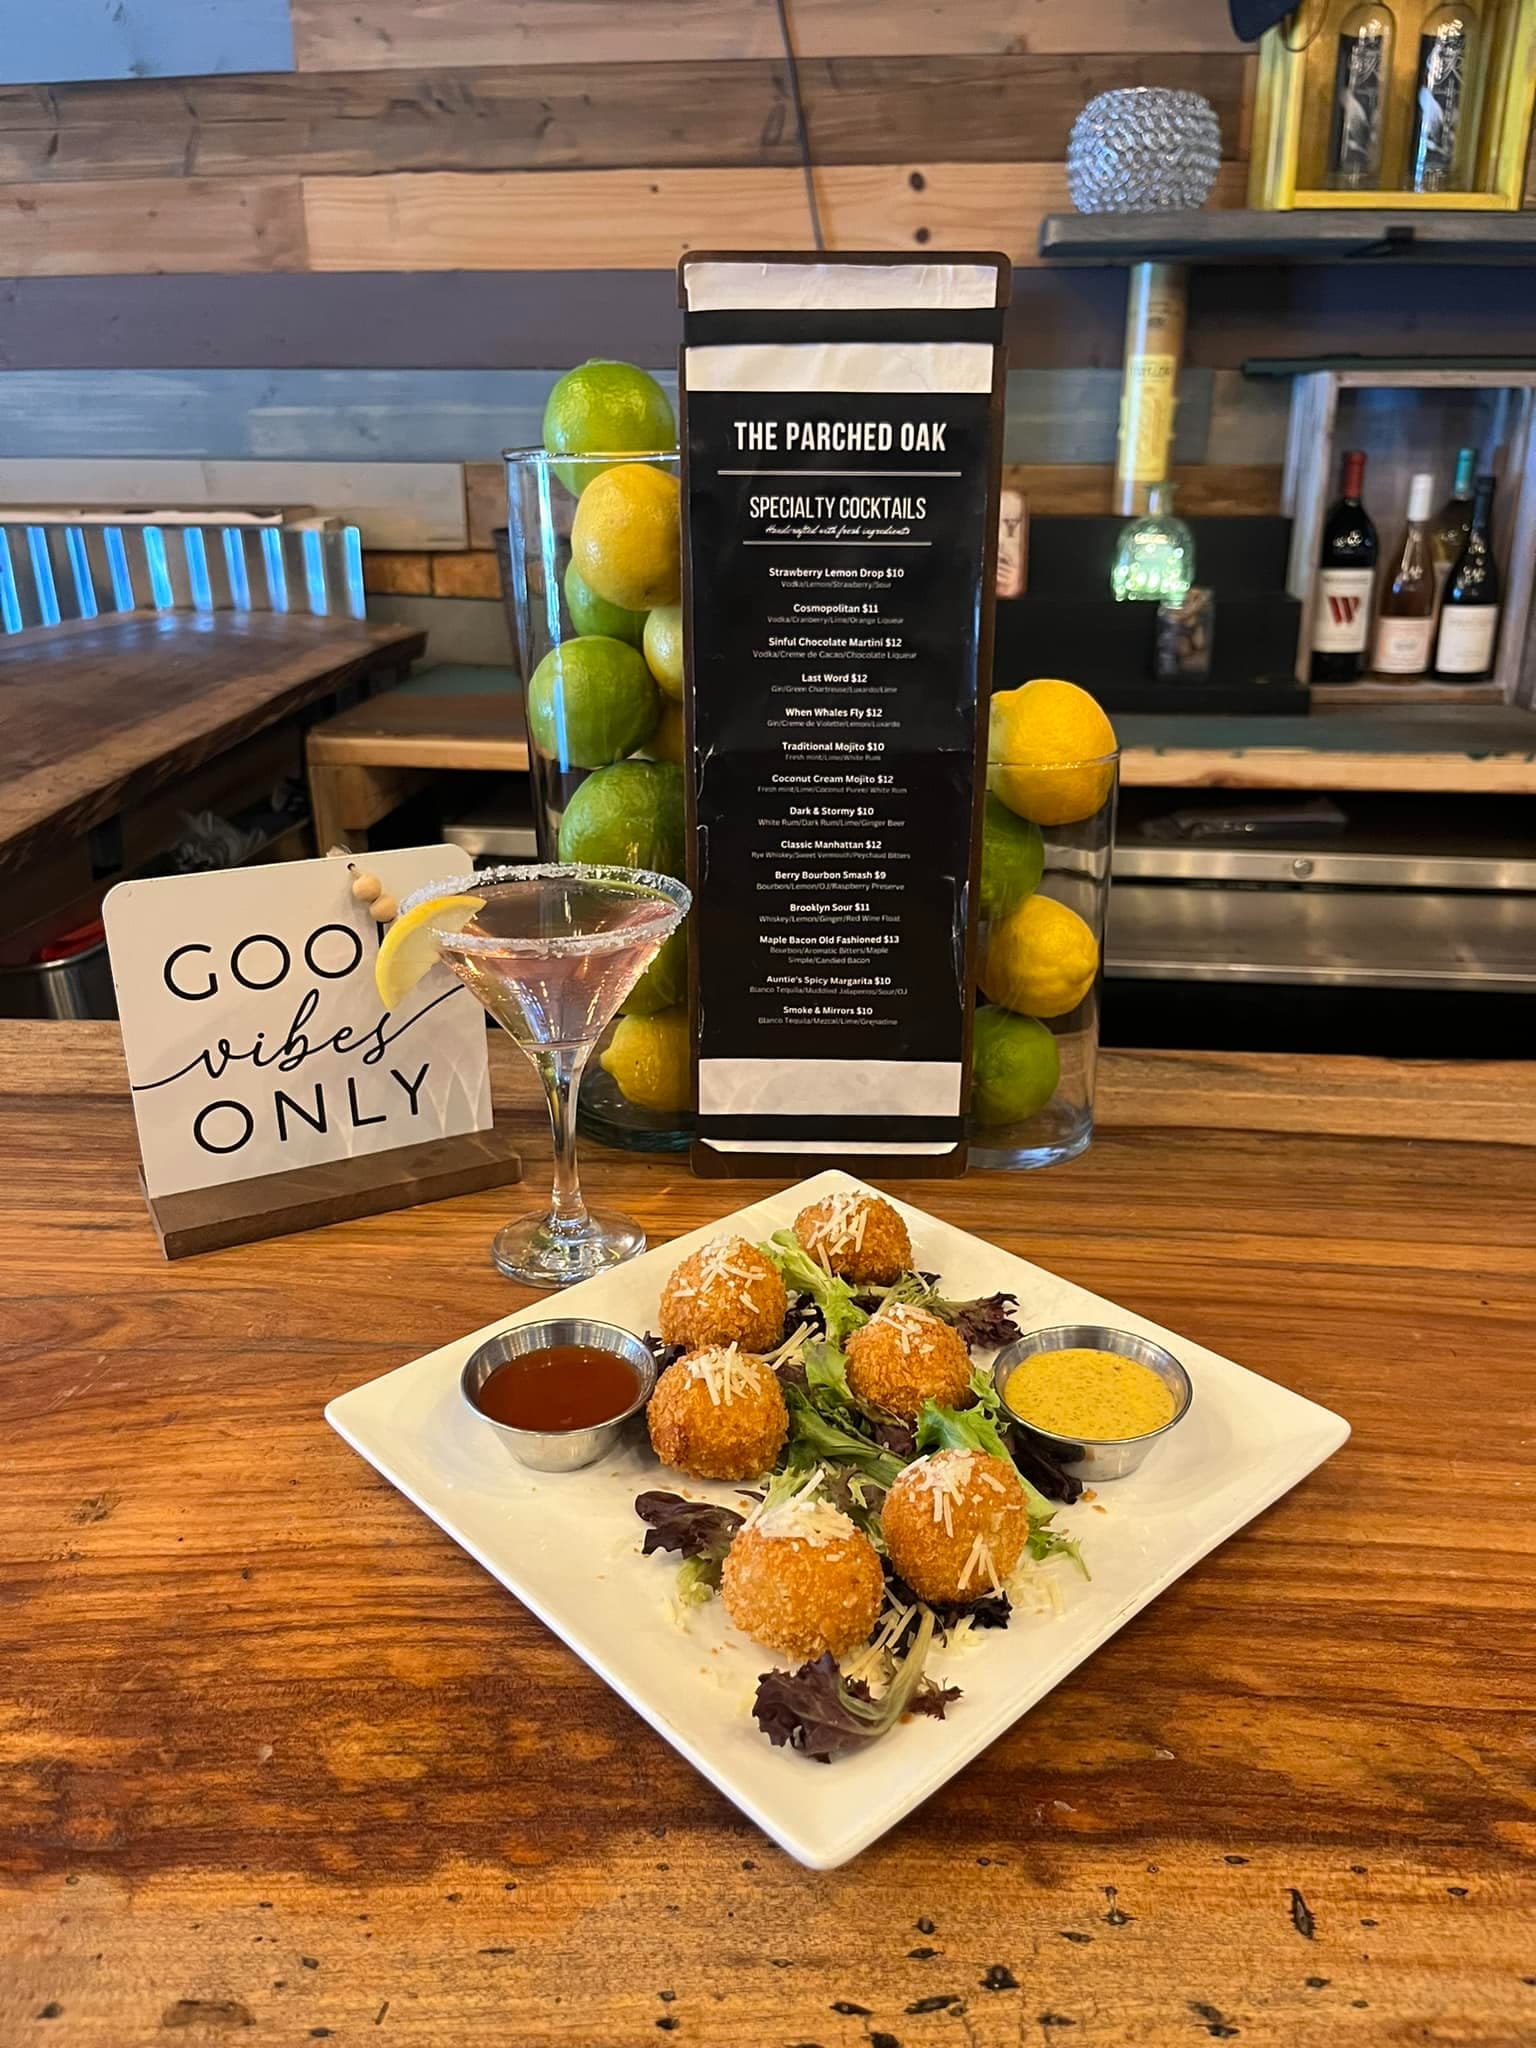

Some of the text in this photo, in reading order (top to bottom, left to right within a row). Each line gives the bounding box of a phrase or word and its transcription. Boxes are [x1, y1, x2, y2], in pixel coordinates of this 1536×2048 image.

[734, 422, 947, 451] THE PARCHED OAK
[750, 496, 926, 519] SPECIALTY COCKTAILS
[818, 525, 836, 538] with
[834, 525, 861, 538] fresh
[862, 525, 910, 539] ingredients
[769, 568, 904, 579] Strawberry Lemon Drop $10
[793, 604, 878, 614] Cosmopolitan $11
[1328, 596, 1361, 624] W
[769, 637, 902, 647] Sinful Chocolate Martini $12
[887, 651, 917, 659] Liqueur
[802, 673, 867, 683] Last Word $12
[785, 708, 882, 719] When Whales Fly $12
[782, 742, 885, 752] Traditional Mojito $10
[772, 774, 893, 785] Coconut Cream Mojito $12
[790, 807, 874, 817] Dark & Stormy $10
[820, 819, 885, 828] Rum/Lime/Ginger
[781, 840, 812, 848] Classic
[866, 840, 882, 849] $12
[775, 871, 886, 881] Berry Bourbon Smash $9
[790, 904, 830, 913] Brooklyn
[855, 903, 869, 911] $11
[760, 935, 899, 945] Maple Bacon Old Fashioned $13
[163, 921, 389, 1000] GOO
[788, 956, 846, 964] Simple/Candied
[767, 976, 891, 986] Auntie's Spicy Margarita $10
[784, 1006, 813, 1014] Smoke
[857, 1007, 873, 1015] $10
[132, 988, 466, 1090] vibes
[193, 1063, 430, 1154] ONLY
